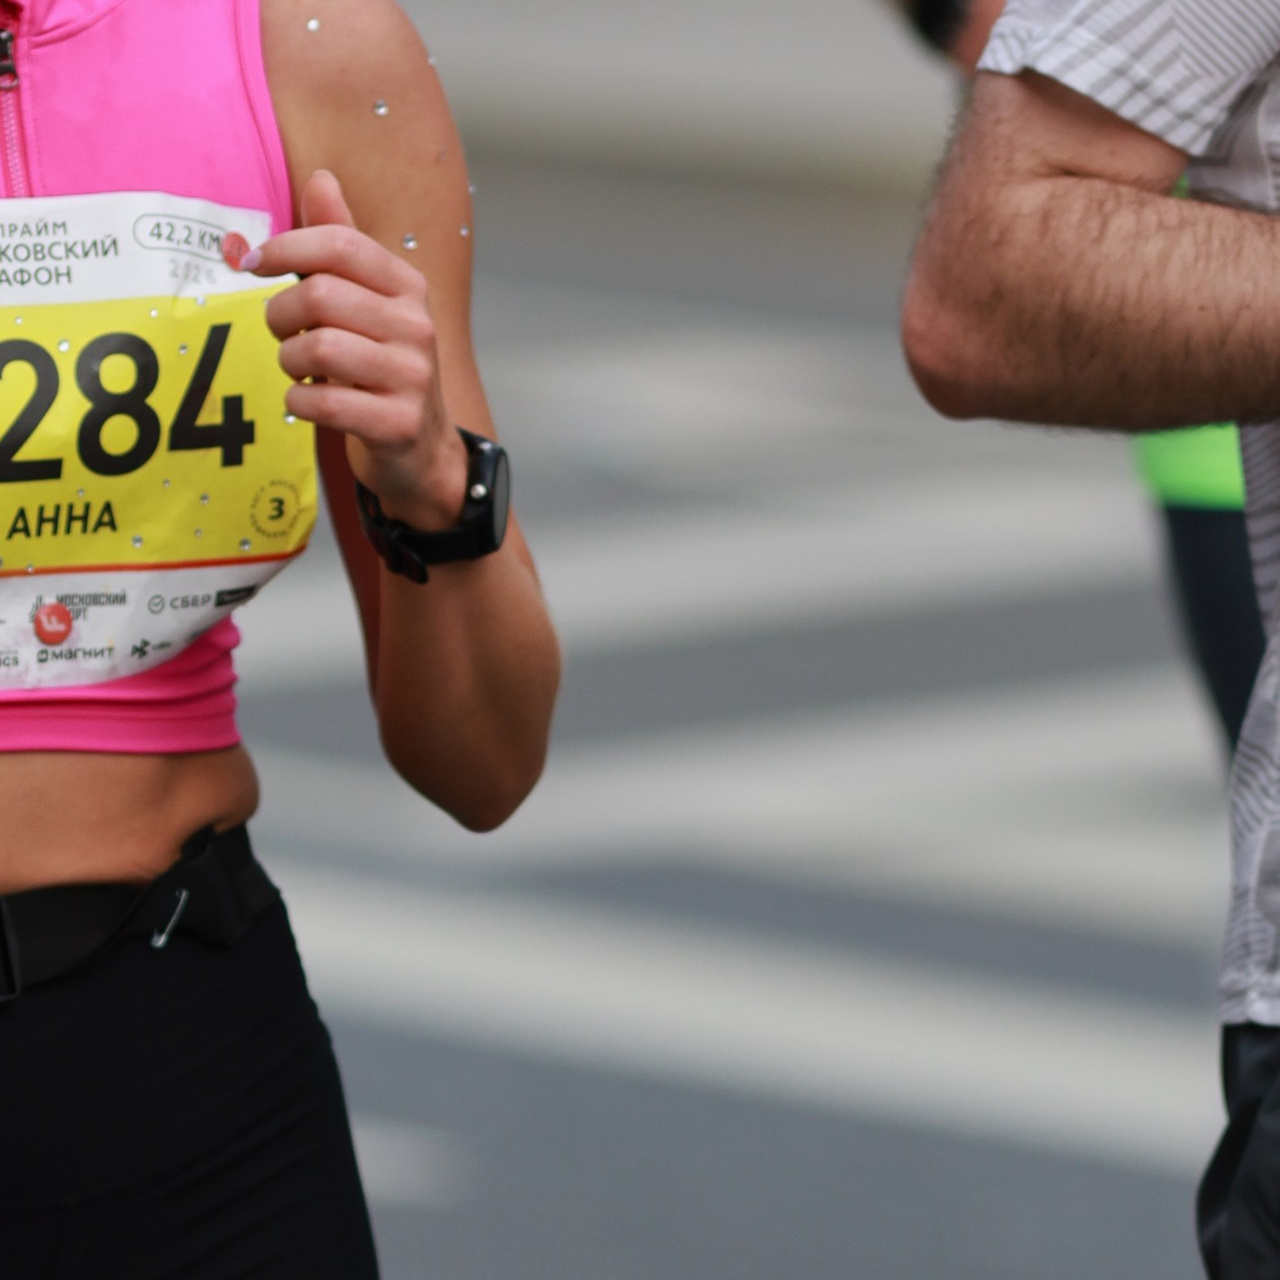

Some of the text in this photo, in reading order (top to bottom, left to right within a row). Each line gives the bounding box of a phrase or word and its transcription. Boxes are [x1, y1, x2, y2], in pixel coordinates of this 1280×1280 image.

[149, 221, 221, 253] 42,2 КМ
[6, 500, 118, 541] АННА
[267, 496, 285, 521] 3
[170, 594, 211, 610] СБЕР
